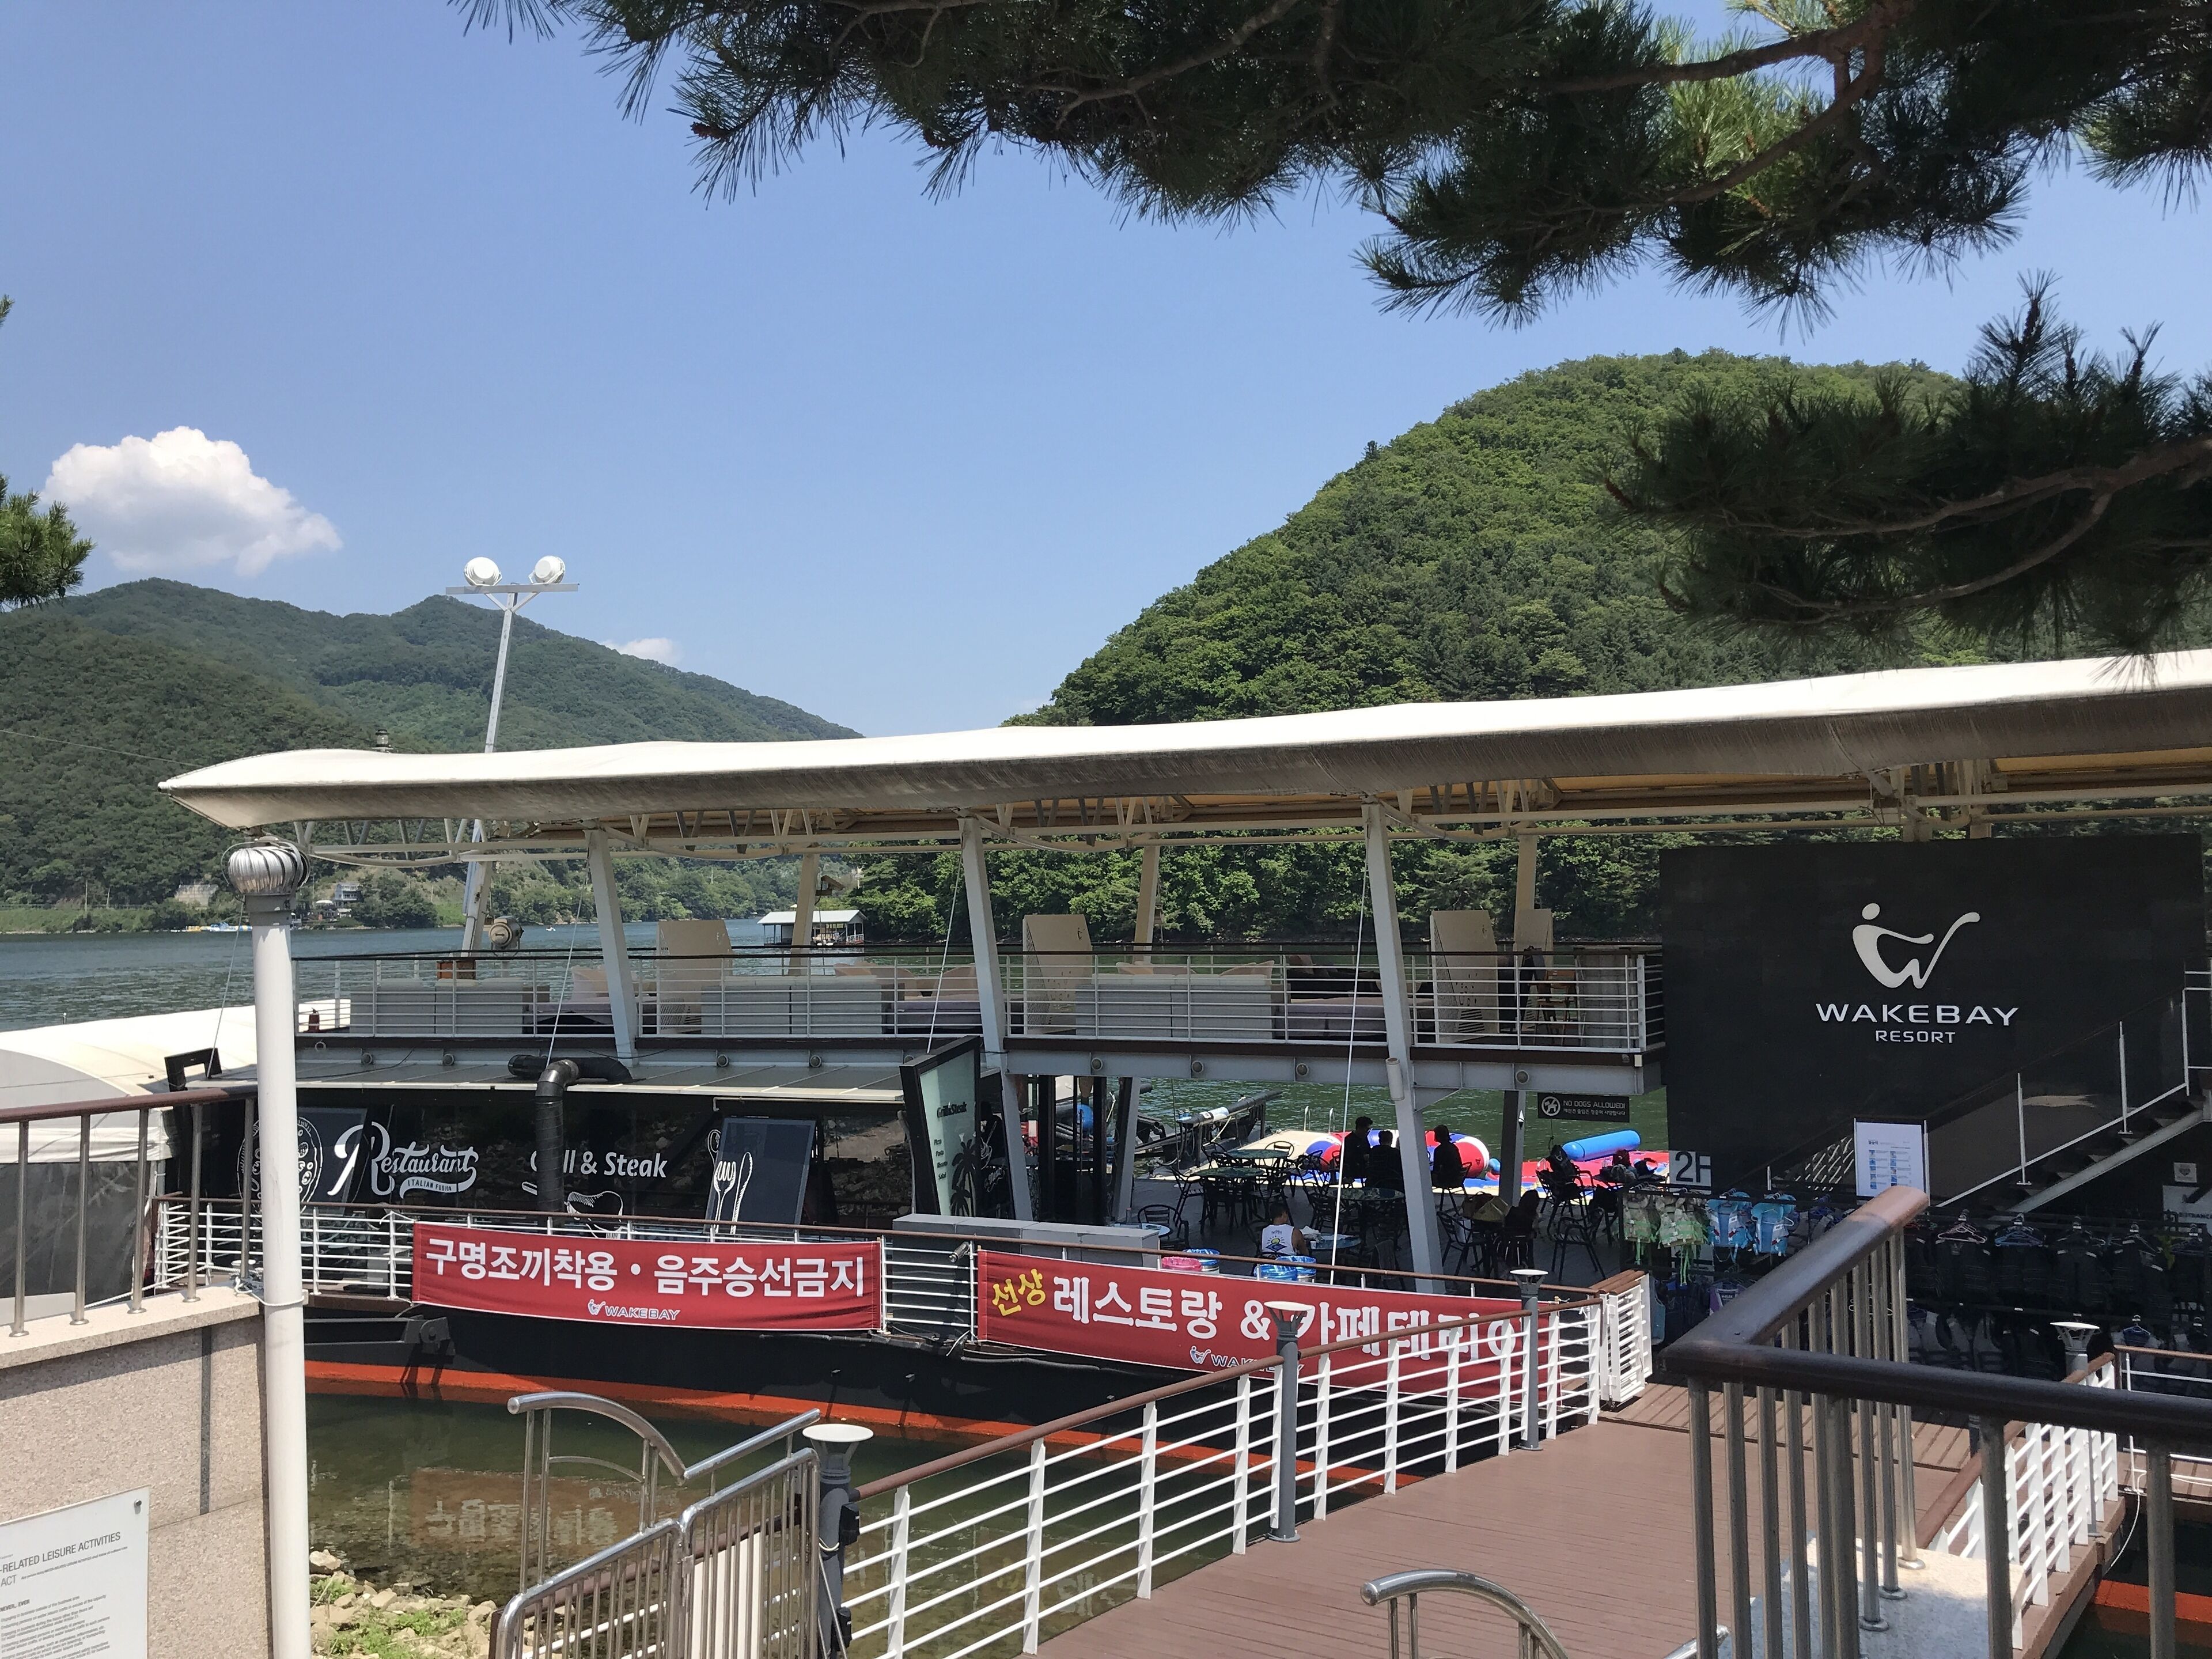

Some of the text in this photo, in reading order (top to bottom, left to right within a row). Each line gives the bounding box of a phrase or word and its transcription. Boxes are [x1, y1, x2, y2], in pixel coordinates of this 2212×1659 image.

[1816, 1003, 2018, 1026] WAKEBAY
[1876, 1030, 1956, 1044] RESORT
[327, 1121, 479, 1196] Restaurant
[581, 1151, 597, 1175] &
[604, 1152, 668, 1177] Steak
[1675, 1151, 1711, 1183] 2F
[408, 1179, 434, 1188] ITALIAN
[426, 1238, 618, 1291] 구명조끼착용
[654, 1255, 863, 1297] 음주승선금지
[605, 1305, 680, 1320] WAKEBAY
[992, 1268, 1046, 1316] 선상
[1054, 1277, 1222, 1339] 레스토랑
[1240, 1300, 1271, 1341] &
[43, 1544, 77, 1562] LEISURE
[78, 1532, 120, 1552] ACTIVITIES
[1, 1574, 17, 1587] ACT
